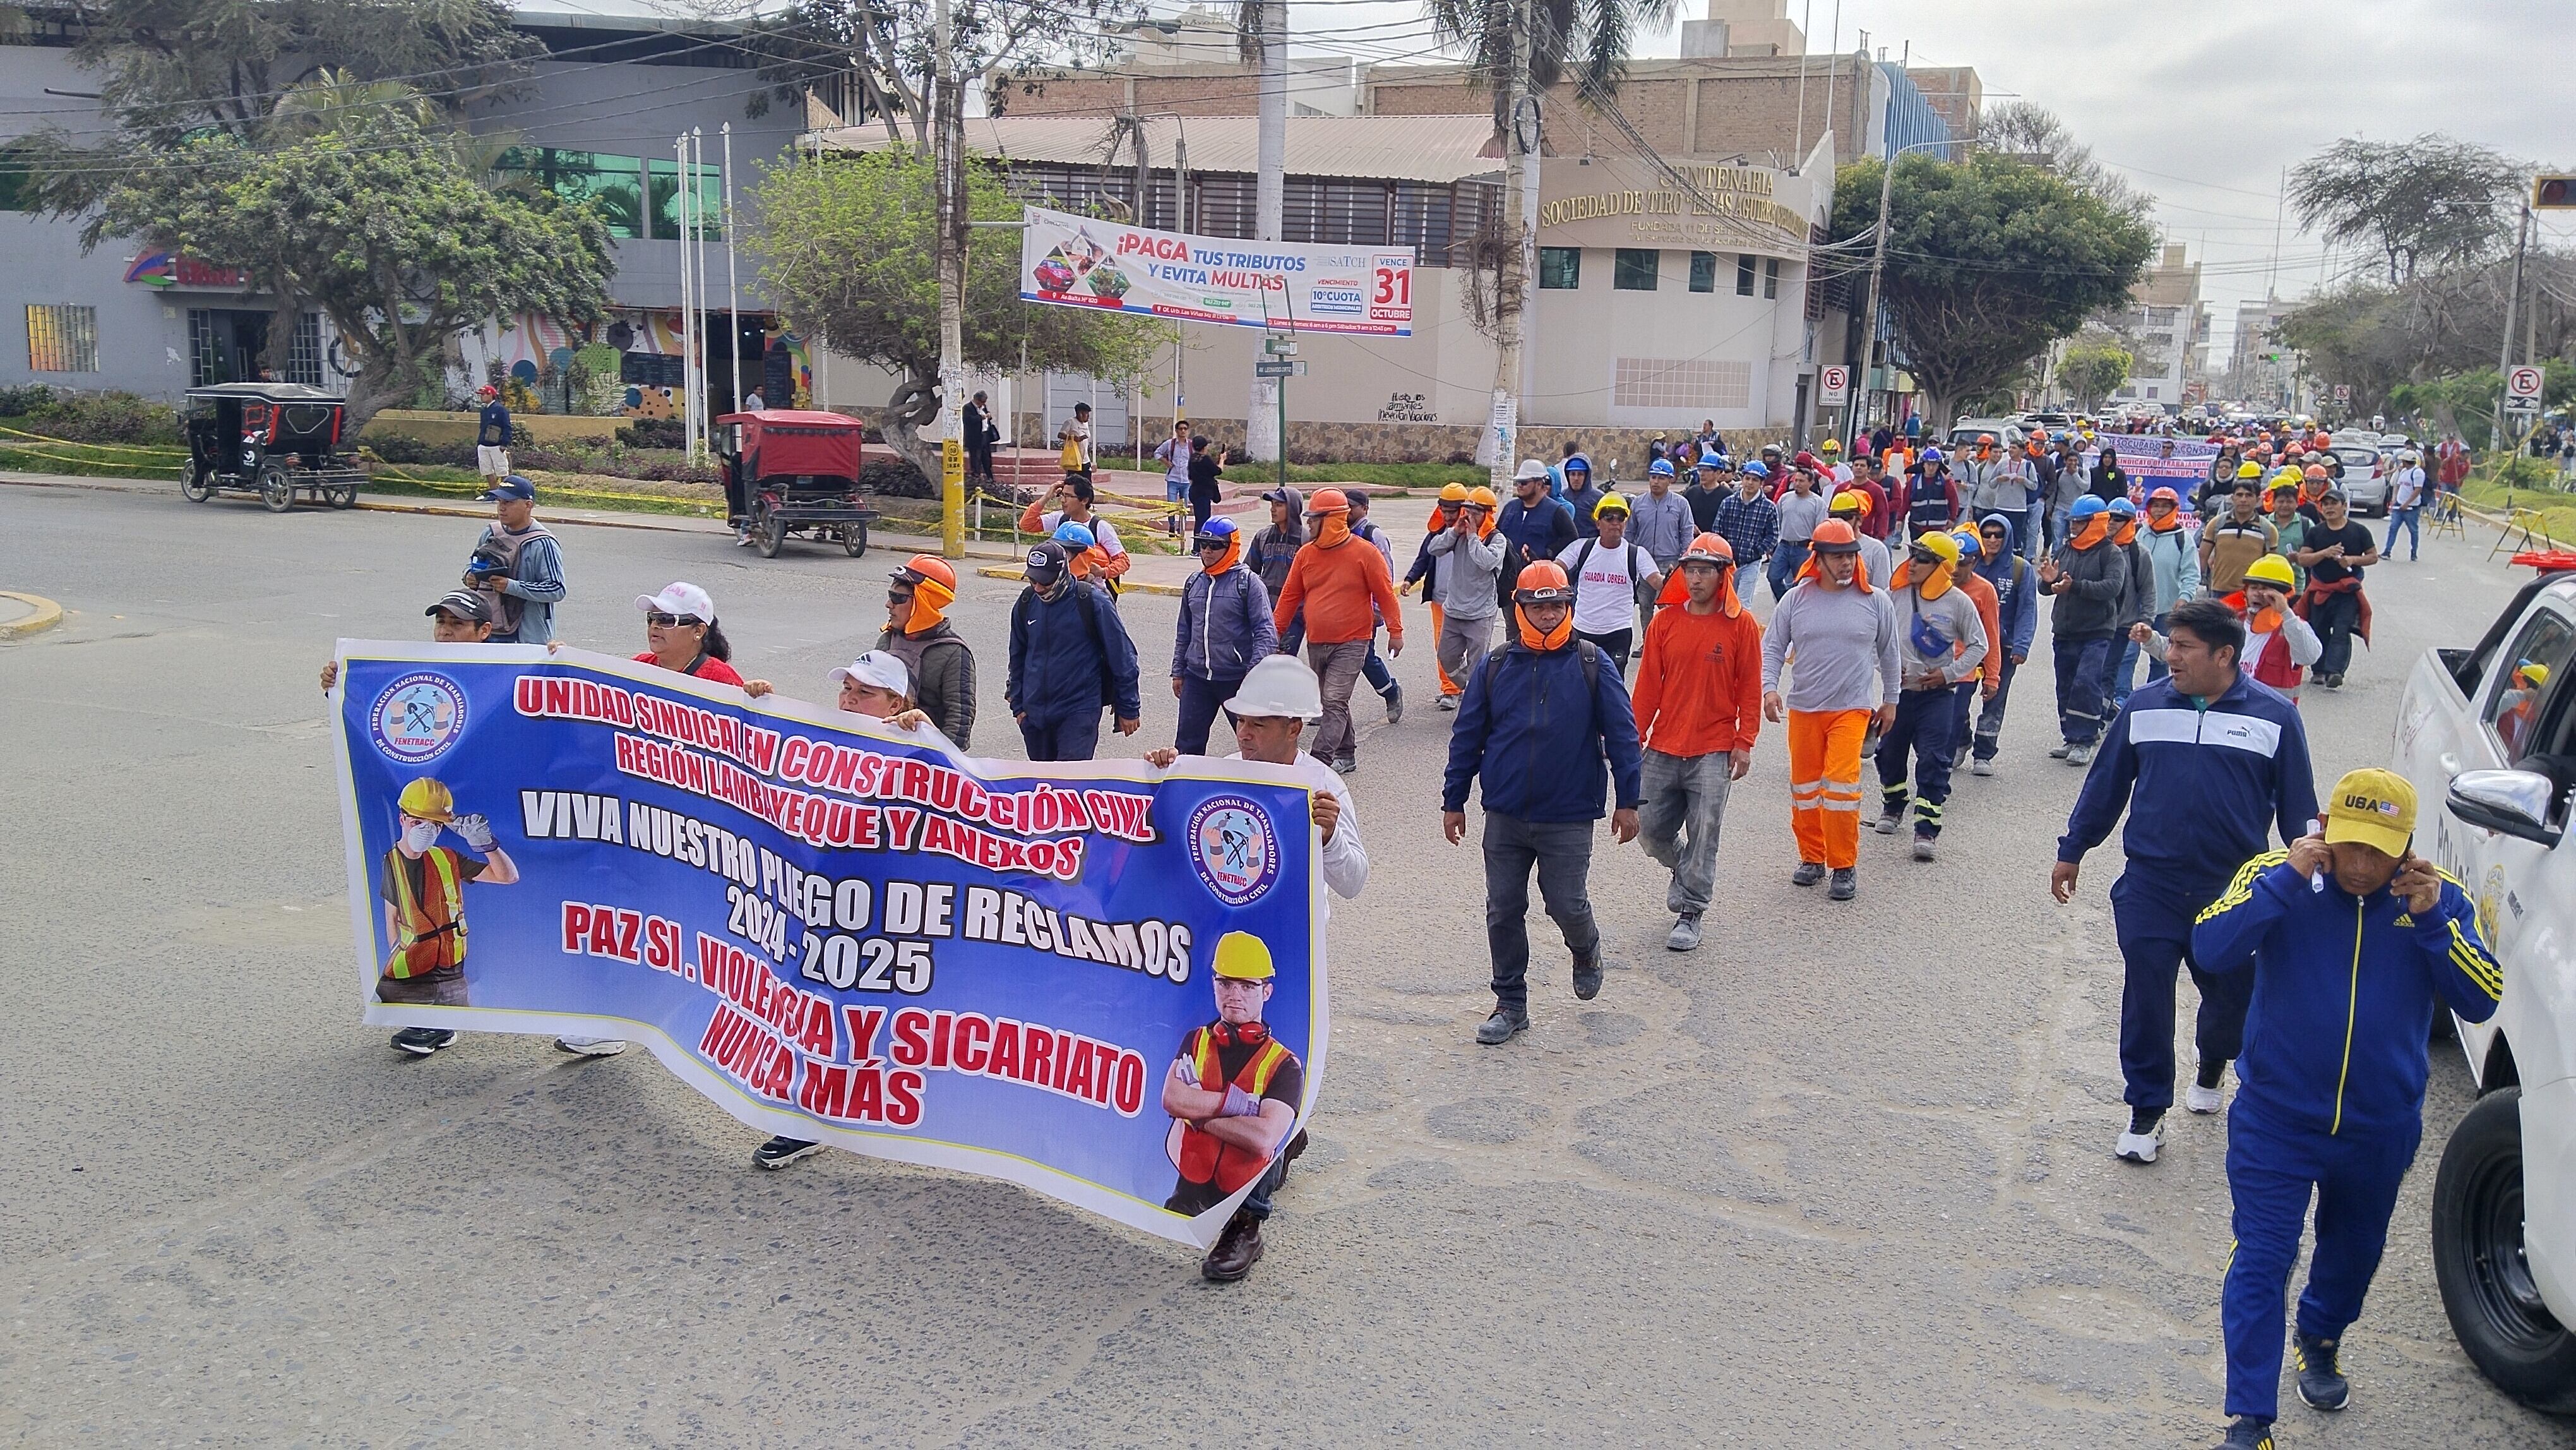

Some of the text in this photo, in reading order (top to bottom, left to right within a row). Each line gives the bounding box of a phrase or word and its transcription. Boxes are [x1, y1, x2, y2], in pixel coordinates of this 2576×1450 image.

[1659, 165, 1774, 196] CENTENARIA
[1541, 192, 1620, 227] SOCIEDAD
[1623, 190, 1643, 214] DE
[1648, 191, 1683, 215] TIRO
[1631, 221, 1681, 234] FUNDADA
[1696, 223, 1710, 234] DE
[1116, 233, 1306, 272] ¡PAGA TUS TRIBUTOS
[1148, 263, 1284, 291] Y EVITA MULTAS
[1374, 268, 1410, 304] 31
[1371, 309, 1410, 318] OCTUBRE
[1584, 572, 1627, 585] GUARDIA OBRERA
[373, 687, 395, 731] FEDERACIÓN
[395, 675, 433, 690] NACIONAL
[445, 681, 464, 734] TRABAJADORES
[376, 738, 451, 762] DE CONSTRUCCIÓN CIVIL
[394, 738, 435, 746] FENETRACC
[515, 676, 1156, 841] UNIDAD SINDICAL EN CONSTRUCCIÓN CIVIL
[616, 733, 1085, 880] REGIÓN LAMBAYEQUE Y ANEXOS
[2345, 794, 2378, 812] USA
[1190, 799, 1276, 875] FEDERACIÓN NACIONAL DE TRABAJADORES
[522, 791, 1192, 983] VIVA NUESTRO PLIEGO DE RECLAMOS
[1200, 872, 1209, 882] DE
[1249, 883, 1268, 899] CIVIL
[802, 931, 933, 993] 2025
[563, 902, 641, 963] PAZ
[698, 932, 837, 1061] VIOLENCIA
[846, 1007, 885, 1061] Y
[891, 1010, 1147, 1117] SICARIATO
[698, 1004, 924, 1127] NUNCA MÁS
